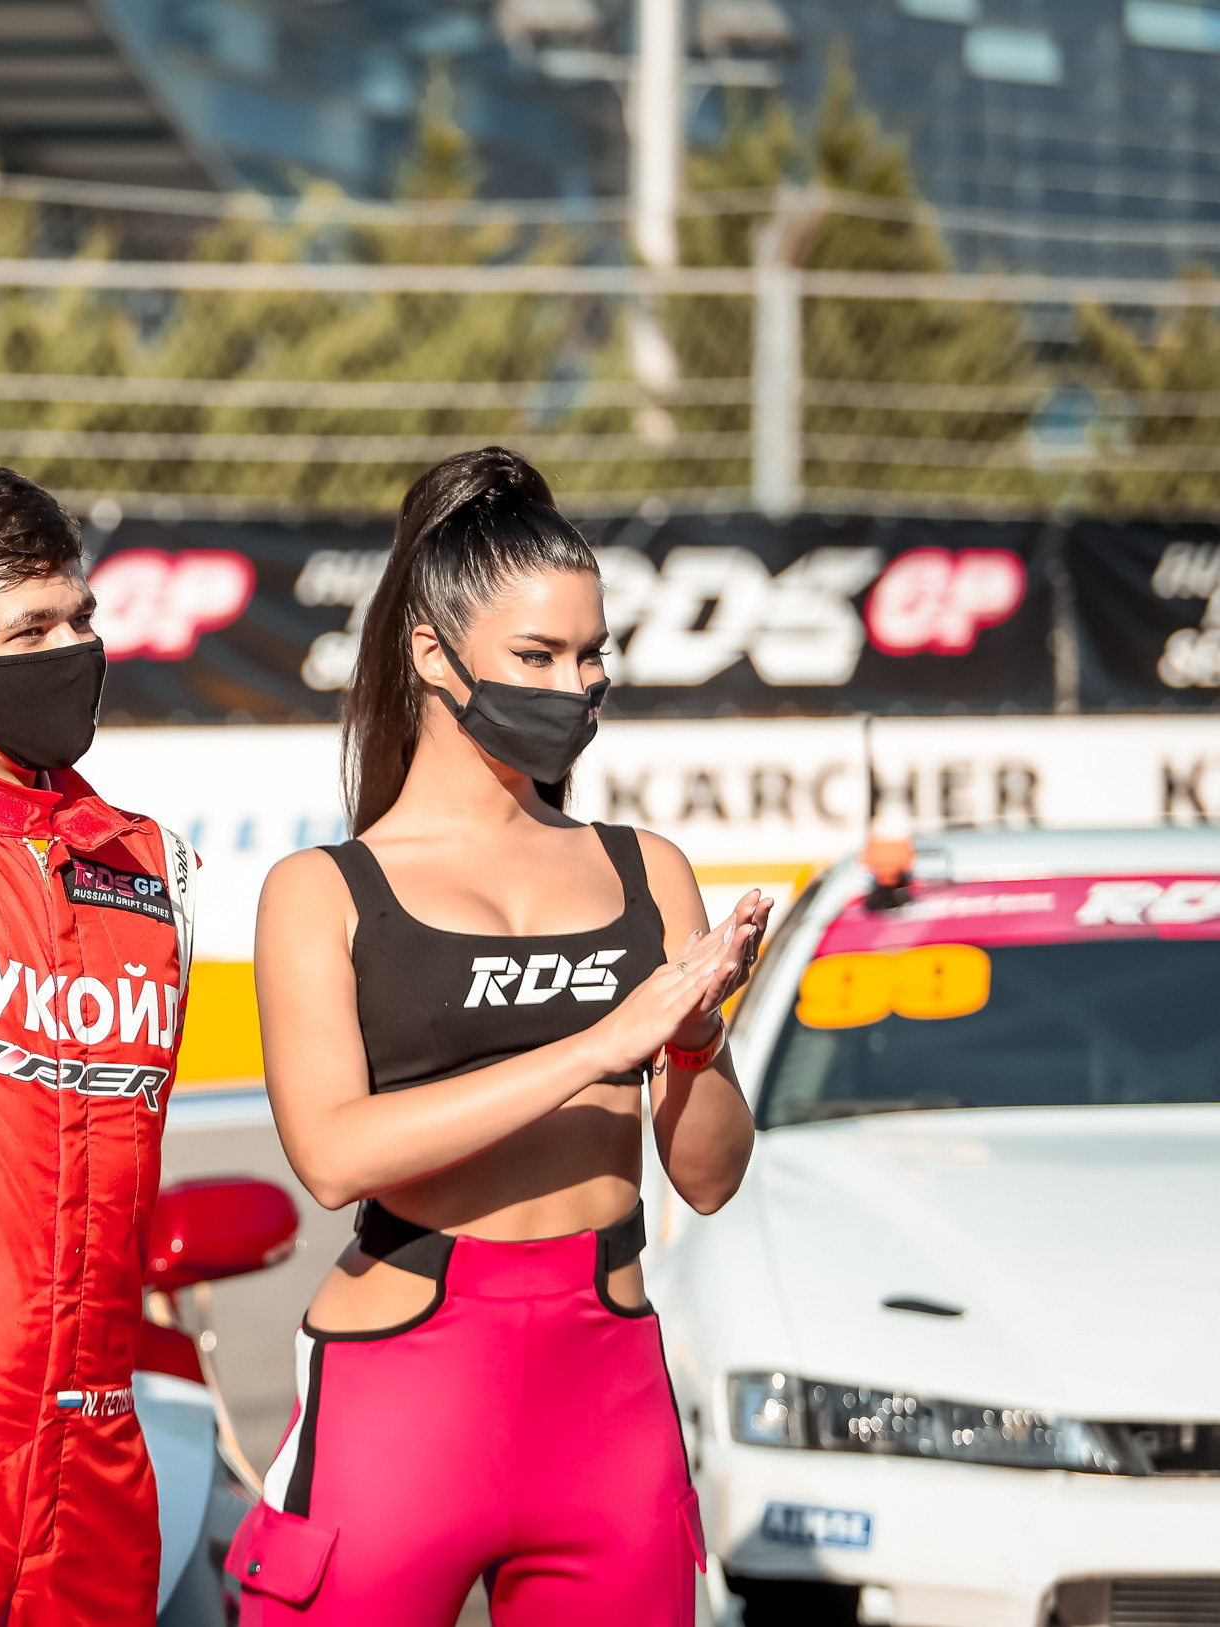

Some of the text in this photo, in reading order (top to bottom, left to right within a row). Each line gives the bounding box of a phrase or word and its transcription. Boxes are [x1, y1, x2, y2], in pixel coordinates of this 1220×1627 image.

[86, 549, 256, 660] GP
[866, 547, 1027, 655] GP
[73, 861, 163, 898] RDS GP
[73, 888, 170, 919] RUSSIAN DRIFT SERIES
[1074, 880, 1220, 926] RD
[463, 949, 627, 1008] RDS
[81, 1390, 99, 1417] N.
